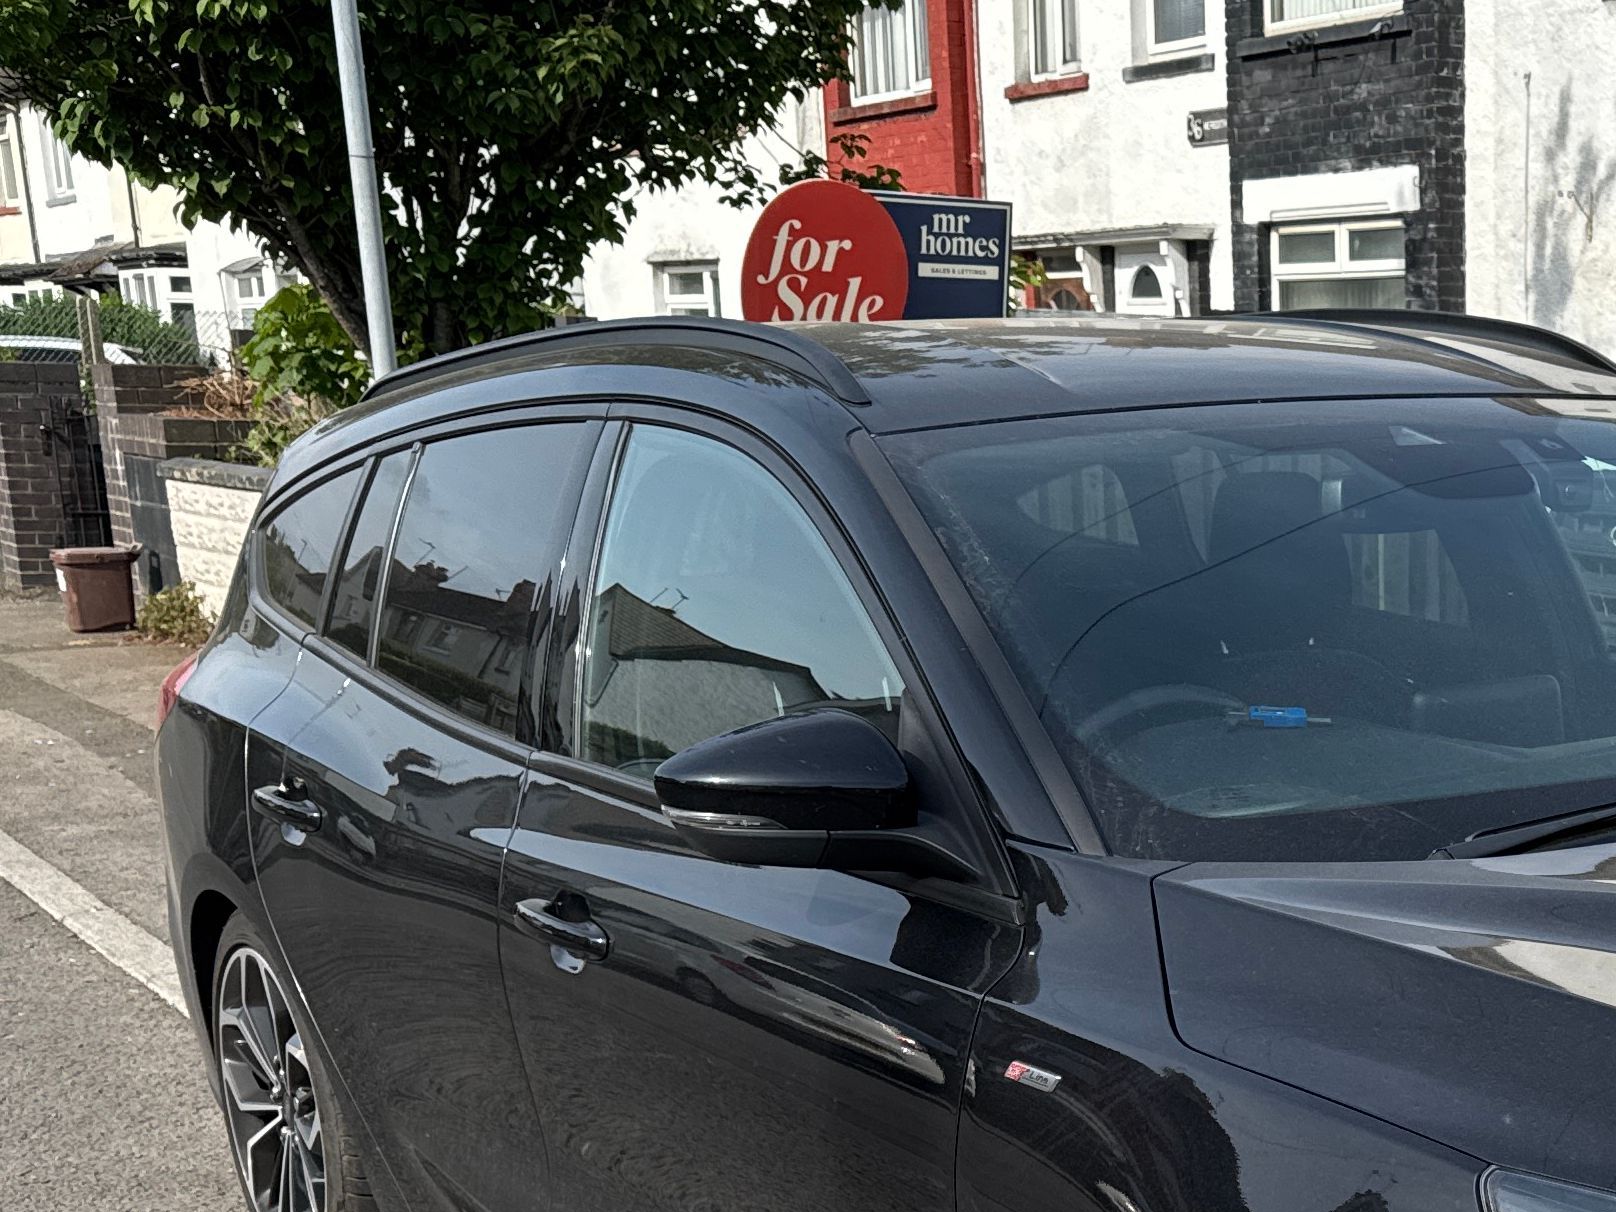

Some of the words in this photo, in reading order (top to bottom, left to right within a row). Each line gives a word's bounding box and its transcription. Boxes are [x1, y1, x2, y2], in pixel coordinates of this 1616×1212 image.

[920, 225, 999, 258] homes
[932, 213, 970, 234] mr
[757, 219, 852, 285] for
[771, 274, 884, 323] Sale
